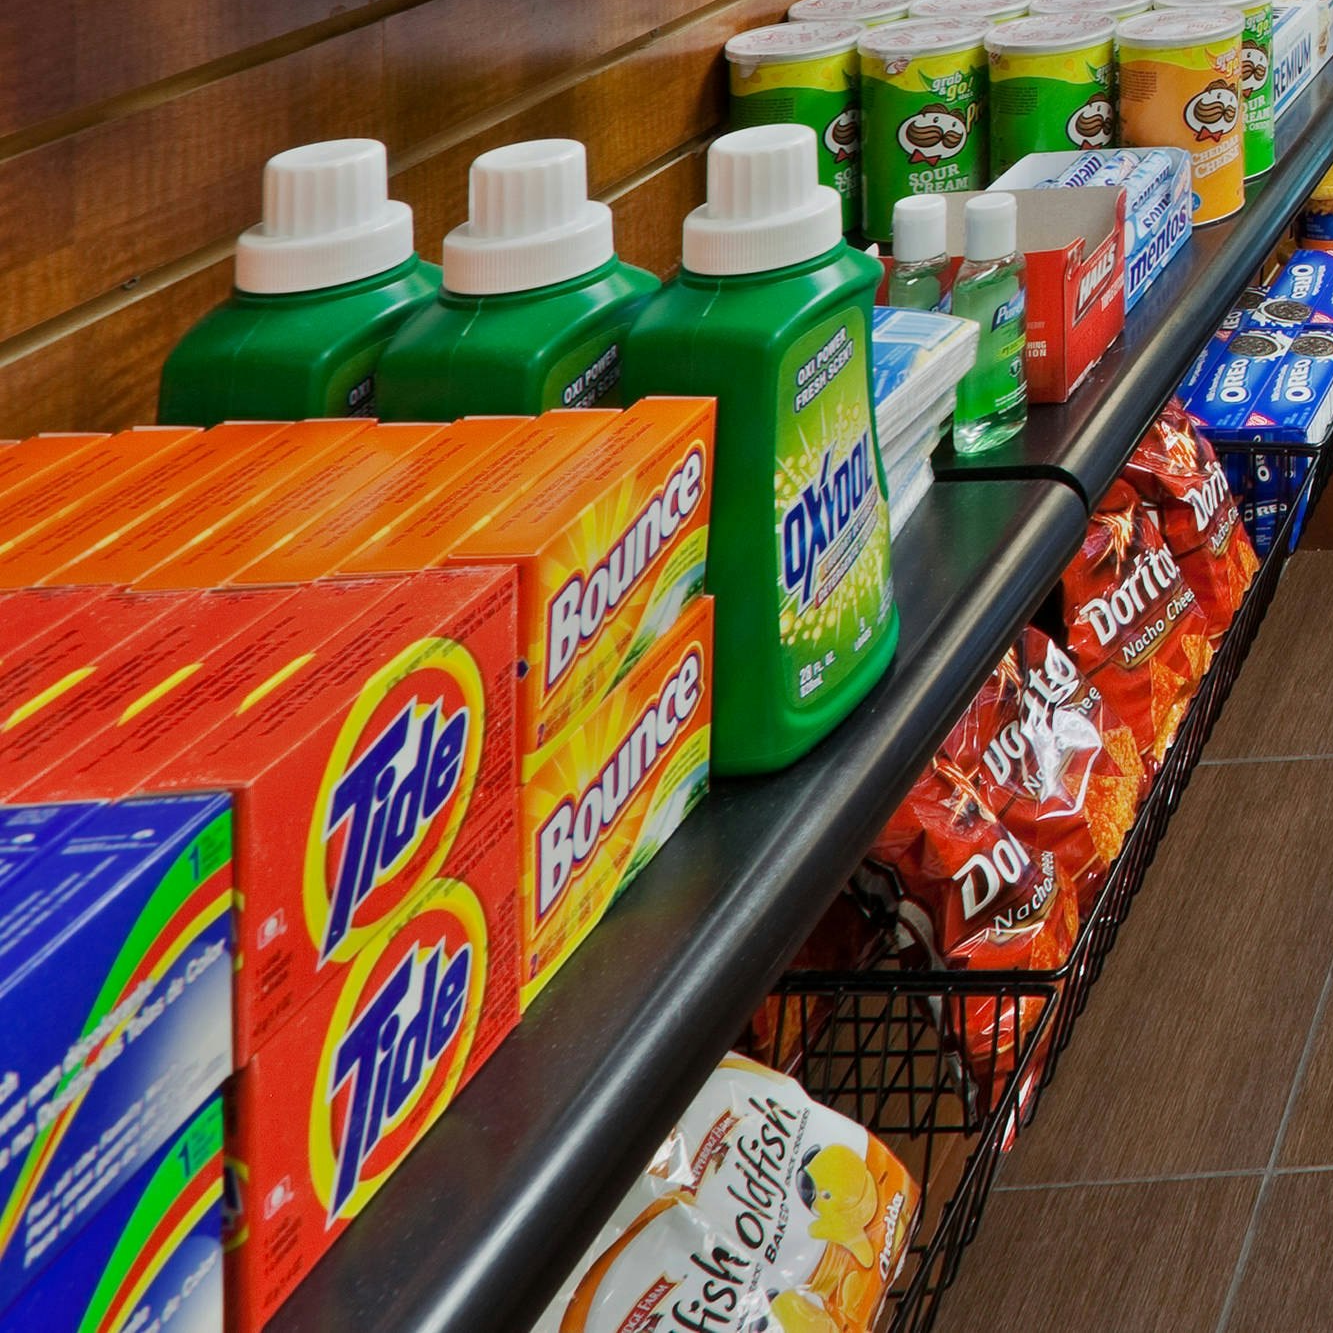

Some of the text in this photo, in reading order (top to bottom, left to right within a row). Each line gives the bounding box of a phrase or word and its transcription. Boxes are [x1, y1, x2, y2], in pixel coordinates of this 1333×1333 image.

[932, 73, 974, 101] grab go!
[1242, 95, 1265, 112] OUR
[1242, 106, 1271, 125] REAM
[908, 164, 960, 185] SOUR
[912, 174, 969, 195] CREAM
[1077, 241, 1117, 311] HALLS
[1127, 202, 1189, 296] mentos
[1290, 264, 1314, 299] OREO
[562, 343, 618, 405] OXI POWER
[794, 338, 854, 414] FRESH SCENT
[796, 325, 847, 387] OXI POWER
[1219, 358, 1249, 404] OREO
[1284, 358, 1313, 404] OREO
[782, 431, 873, 614] OXYDOL
[548, 450, 702, 688] Bounce
[1122, 617, 1166, 664] Nacho
[538, 652, 702, 920] Bounce
[317, 695, 469, 971] Tide
[324, 936, 473, 1233] Tide
[177, 1140, 192, 1178] 1
[734, 1096, 799, 1250] oldfish
[764, 1202, 793, 1266] BAKED
[639, 1283, 667, 1311] FARM
